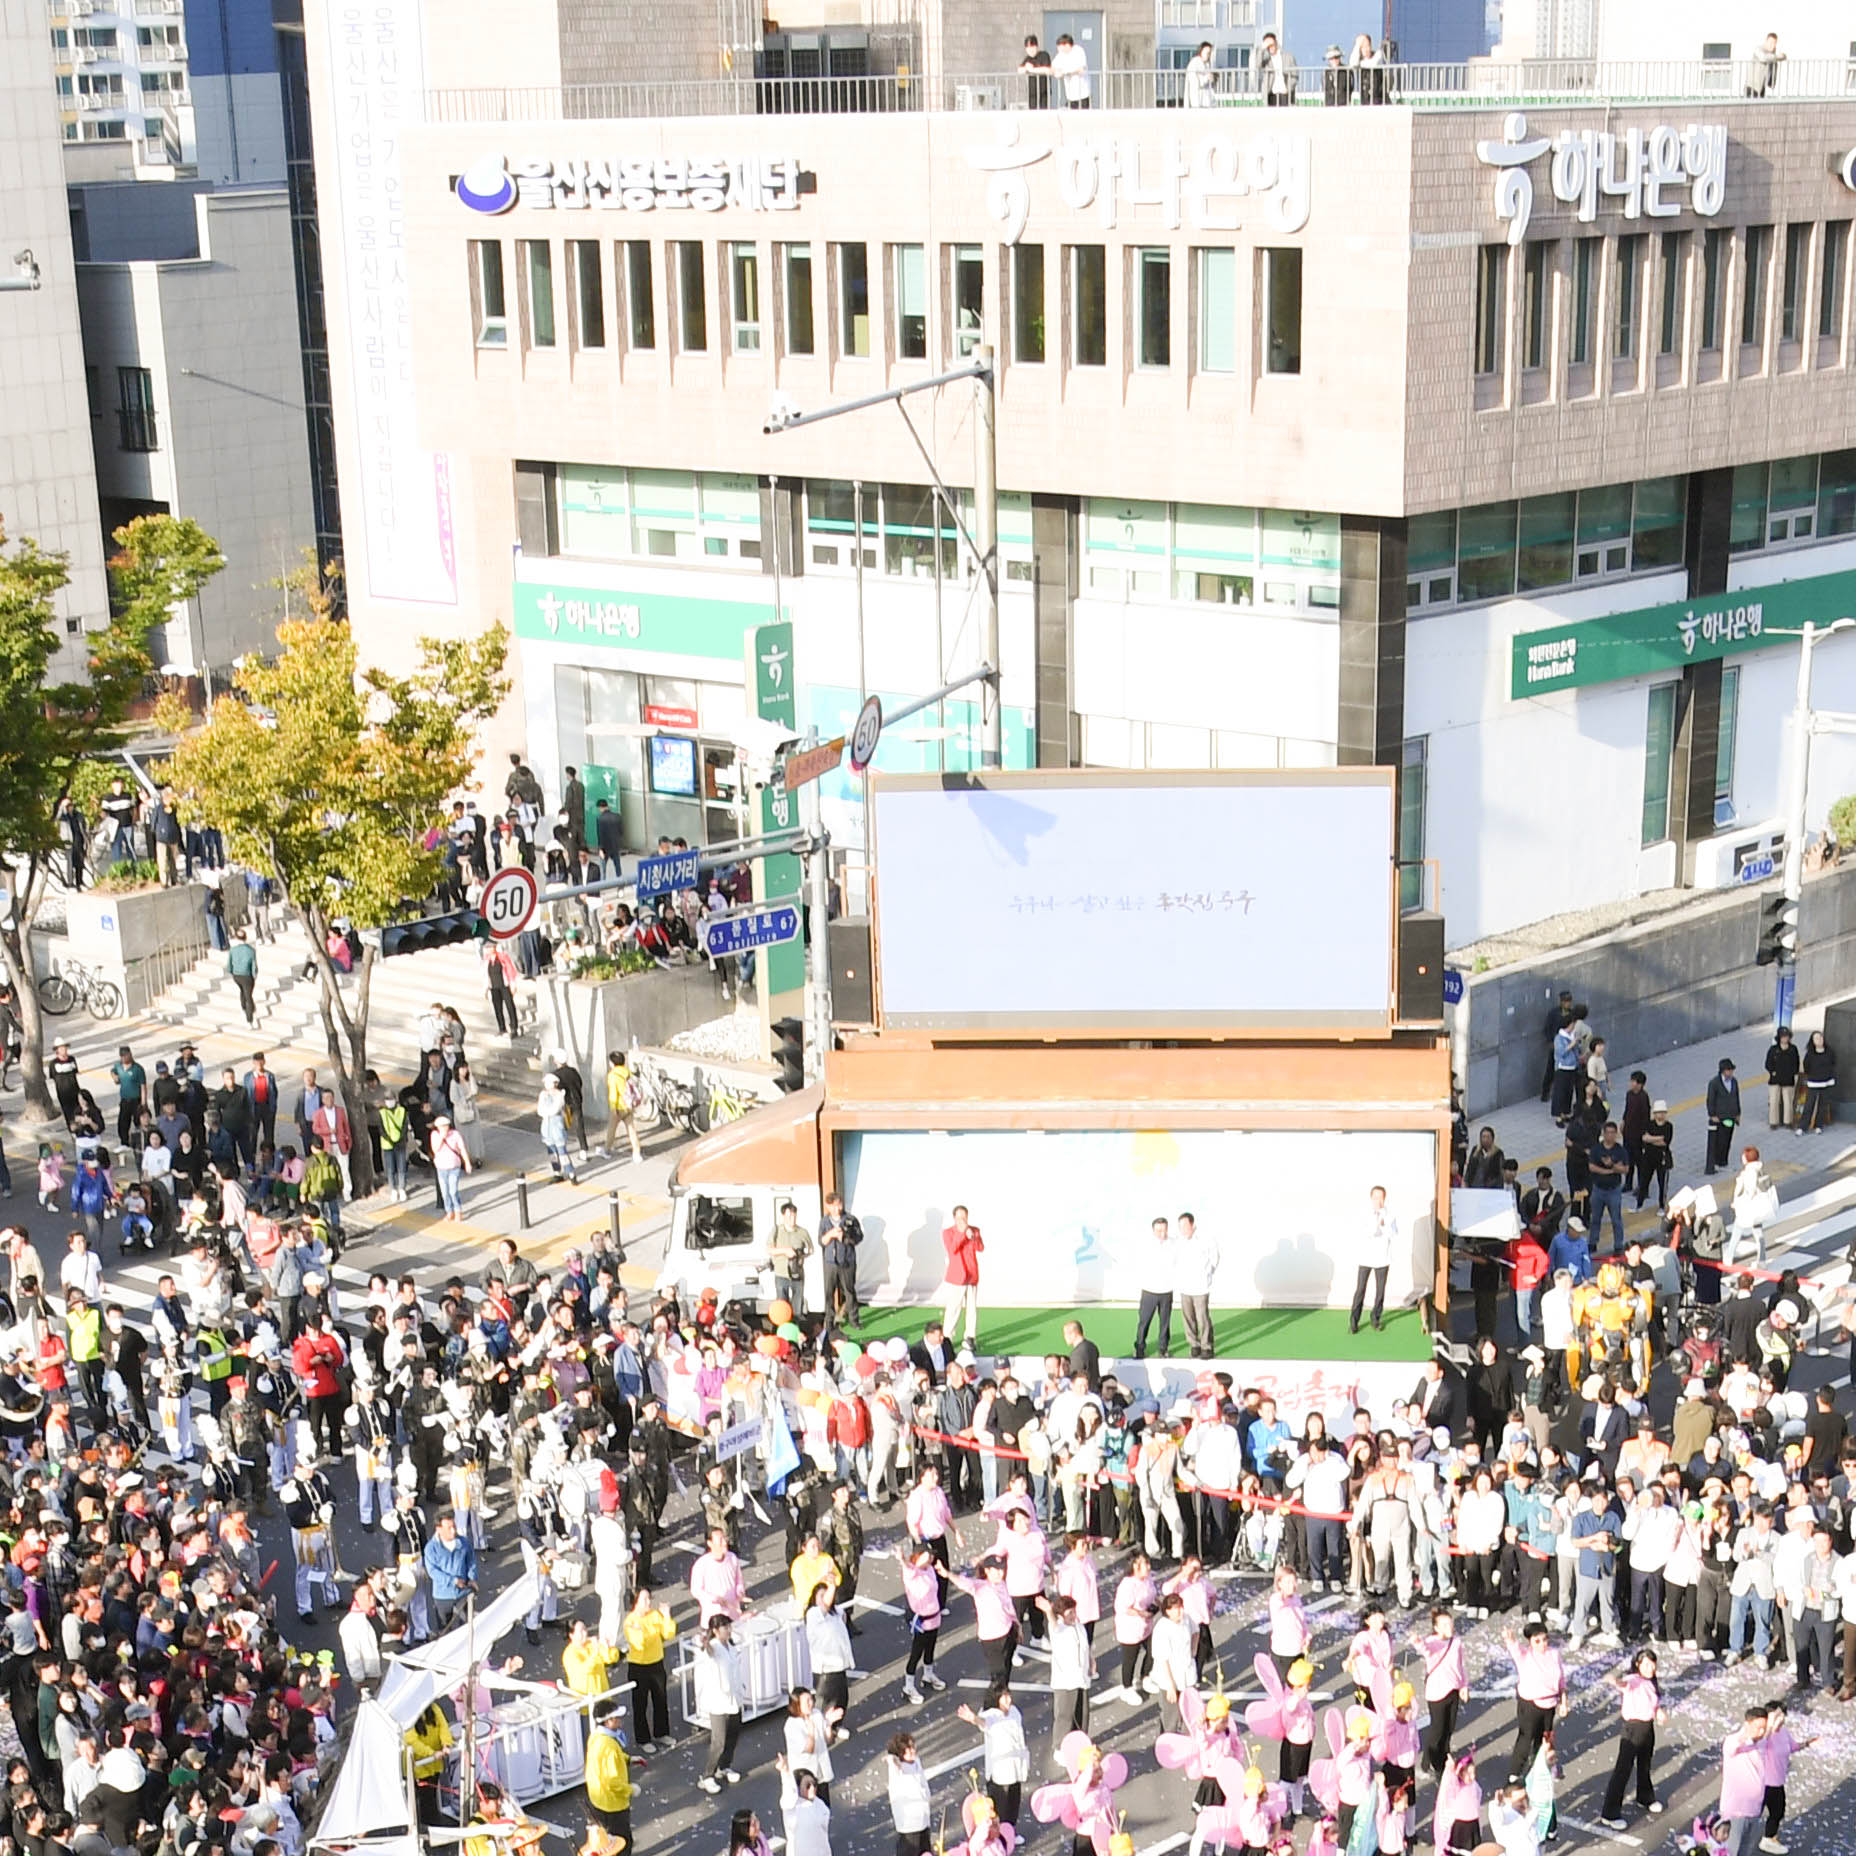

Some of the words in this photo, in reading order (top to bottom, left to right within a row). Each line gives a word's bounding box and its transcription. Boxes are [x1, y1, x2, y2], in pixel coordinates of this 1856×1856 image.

[517, 156, 800, 213] 울산신용보증재단
[1060, 134, 1312, 233] 하나은행
[1553, 122, 1728, 220] 하나은행
[565, 598, 641, 639] 하나은행
[1702, 603, 1763, 645] 하나은행
[639, 855, 697, 891] 시청사거리
[492, 887, 526, 921] 50
[780, 915, 795, 931] 67
[710, 932, 724, 945] 63
